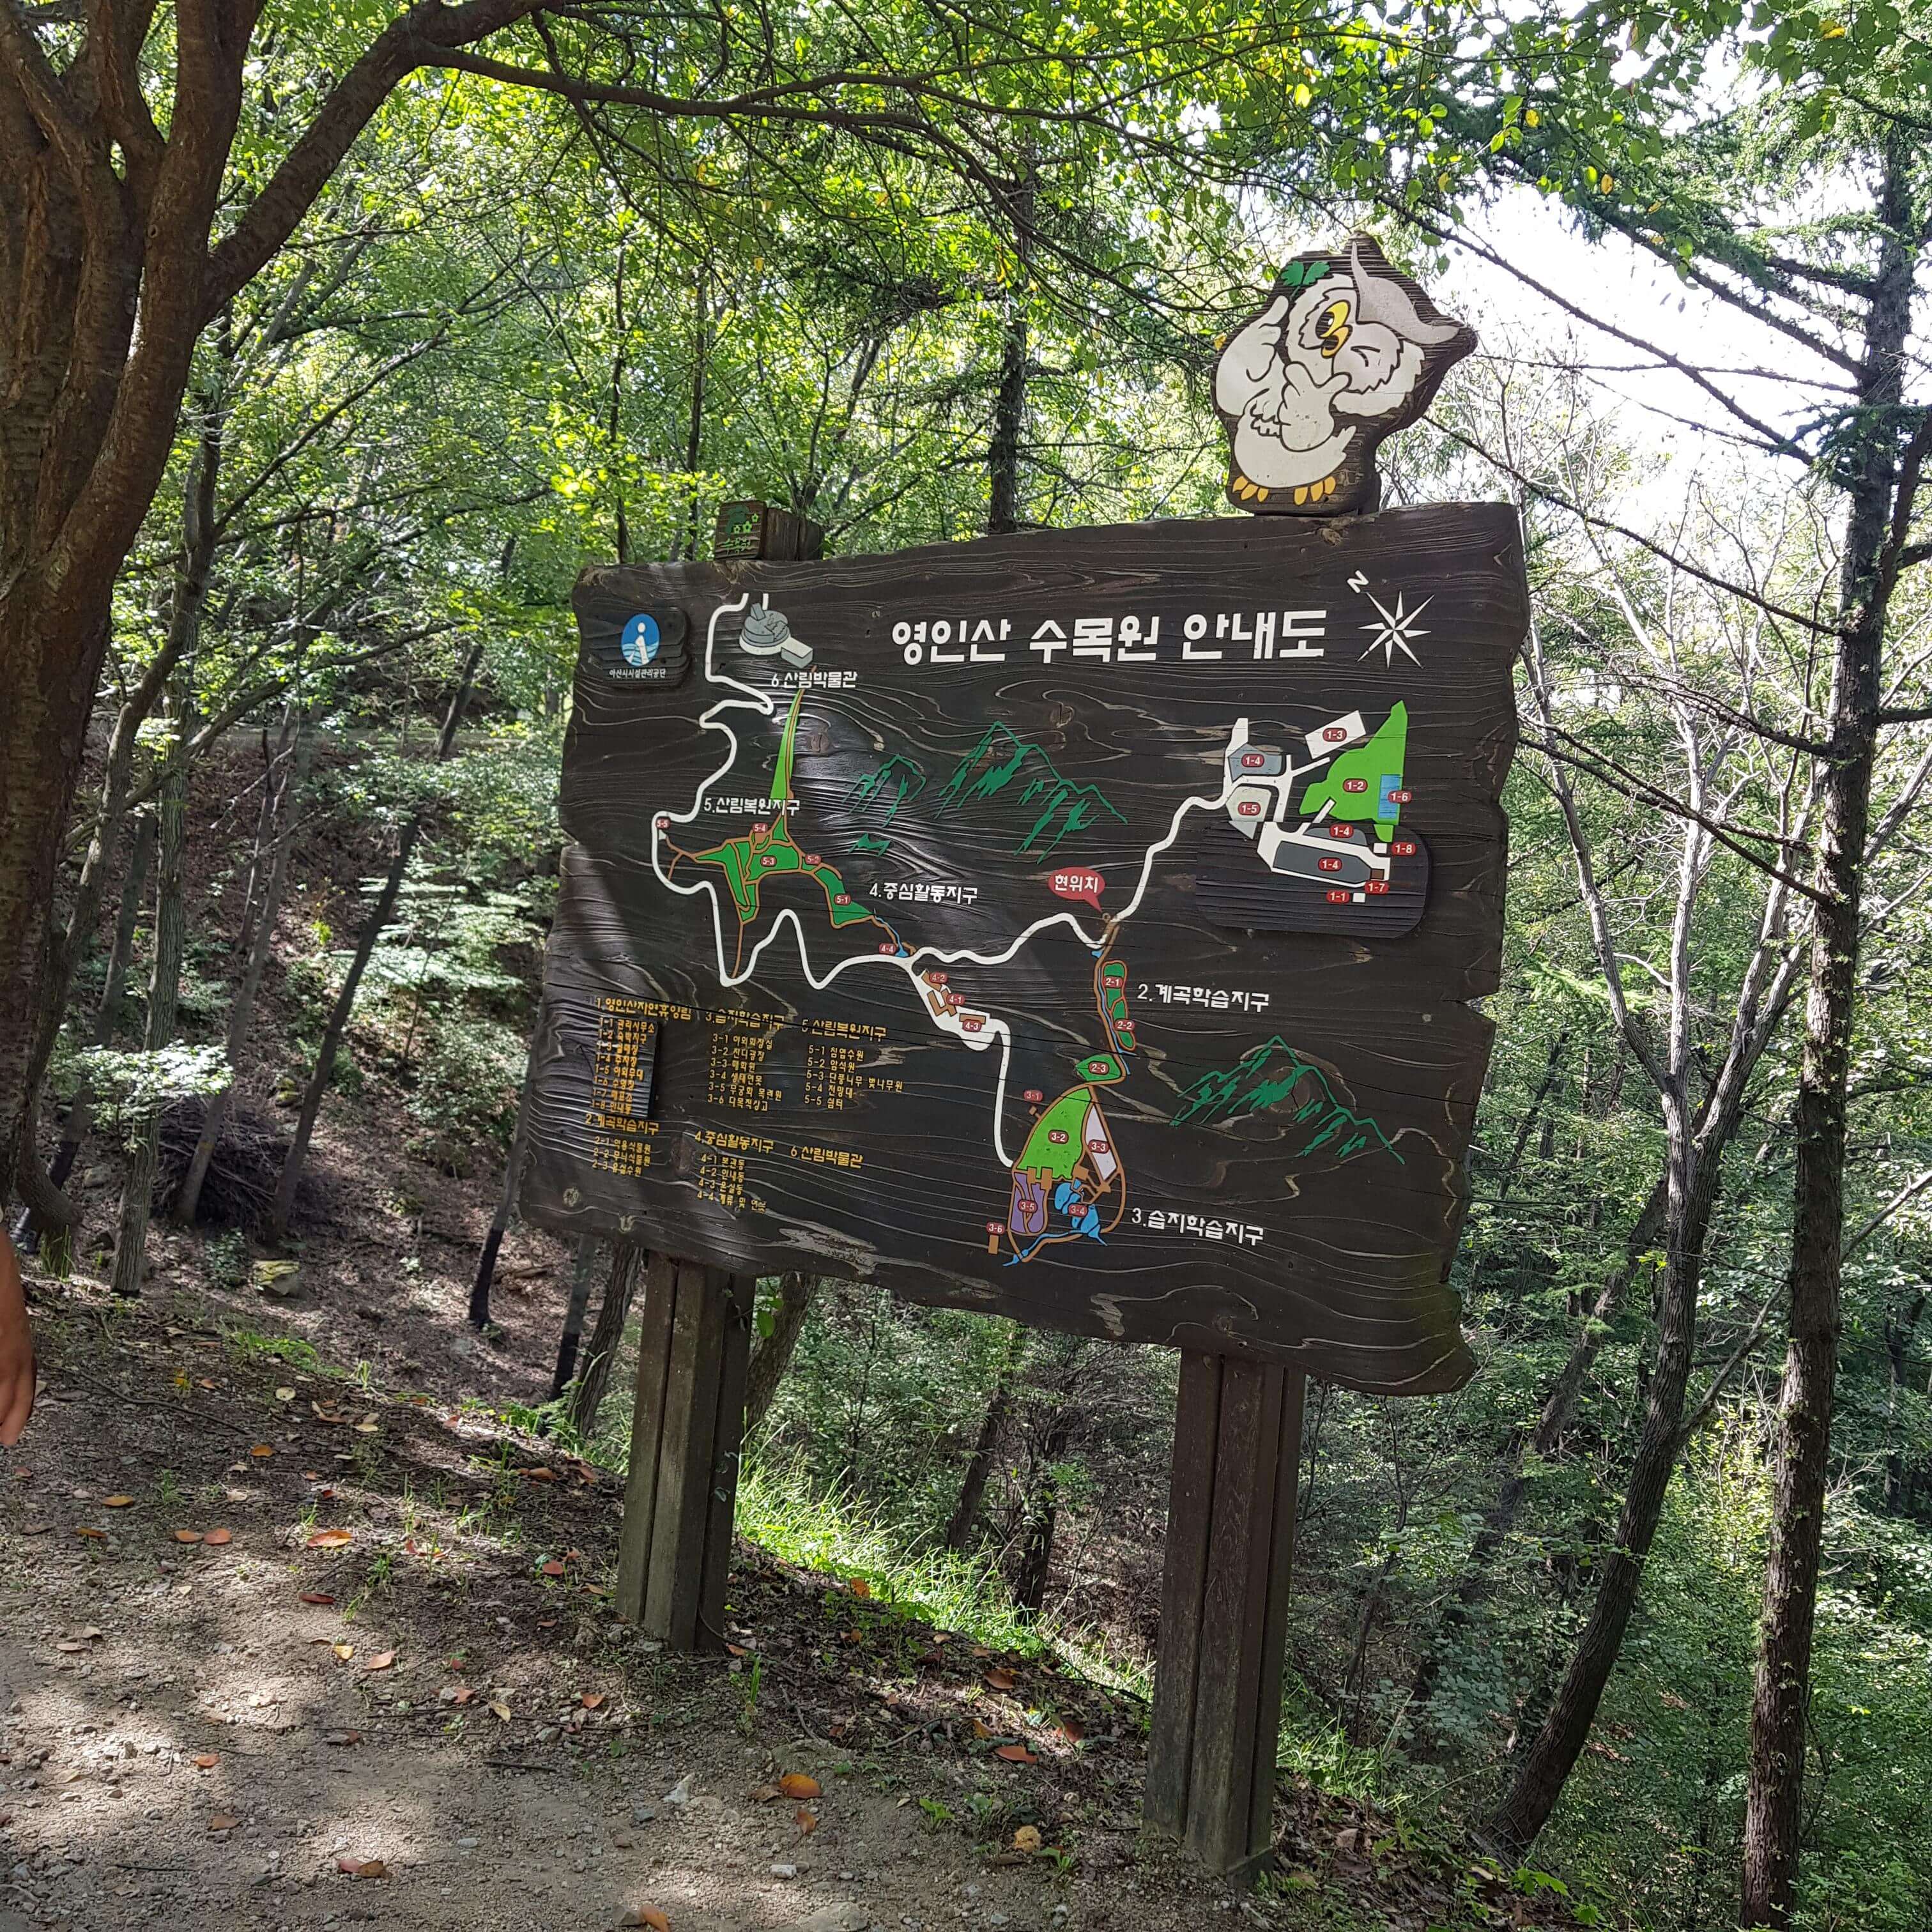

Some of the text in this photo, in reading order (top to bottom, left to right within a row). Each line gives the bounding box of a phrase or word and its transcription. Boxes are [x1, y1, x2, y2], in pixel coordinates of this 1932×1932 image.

[1347, 570, 1368, 593] N
[892, 610, 1326, 665] 영인산 수목원 안내도
[609, 668, 666, 678] 아산시시설관리공단
[1326, 730, 1344, 740] 1-3
[1245, 756, 1261, 766] 1-4
[1347, 781, 1364, 791] 1-2
[1392, 792, 1409, 802] 1-6
[1241, 805, 1257, 814] 1-5
[1333, 827, 1350, 836] 1-4
[1395, 845, 1412, 854] 1-8
[763, 857, 775, 866] 5-3
[807, 855, 820, 864] 5-2
[1322, 861, 1338, 869] 1-4
[1054, 874, 1098, 893] 현위치
[1368, 884, 1385, 893] 1-7
[1330, 893, 1346, 901] 1-1
[881, 944, 894, 953] 4-4
[1105, 978, 1121, 986] 2-1
[599, 1017, 655, 1033] 1-1 관리사무소
[965, 1022, 979, 1030] 4-3
[1117, 1022, 1133, 1030] 2-2
[599, 1029, 613, 1039] 1-2
[712, 1034, 728, 1043] 3-1
[712, 1046, 765, 1062] 3-2 잔디광장
[808, 1045, 825, 1055] 5-1
[597, 1053, 611, 1062] 1-4
[710, 1058, 728, 1068] 3-3
[808, 1057, 855, 1073] 5-2 암석원
[595, 1064, 610, 1074] 1-5
[1092, 1064, 1106, 1073] 2-3
[709, 1070, 726, 1079] 3-4
[806, 1070, 824, 1080] 5-3
[829, 1072, 862, 1087] 단풍나무
[594, 1075, 634, 1091] 1-6 수영장
[593, 1088, 606, 1097] 1-7
[709, 1082, 725, 1092] 3-5
[730, 1084, 753, 1097] 무궁화
[805, 1082, 853, 1098] 5-4 전망대
[707, 1094, 724, 1104] 3-6
[1026, 1091, 1039, 1100] 3-1
[592, 1099, 606, 1110] 1-8
[804, 1095, 843, 1110] 5-5 쉼터
[595, 1136, 609, 1145] 2-1
[1051, 1132, 1066, 1141] 3-2
[1092, 1142, 1106, 1151] 3-3
[594, 1147, 609, 1158] 2-2
[701, 1154, 717, 1164] 4-1
[592, 1159, 608, 1170] 2-3
[700, 1166, 716, 1176] 4-2
[699, 1178, 715, 1189] 4-3
[697, 1190, 714, 1200] 4-4
[1021, 1202, 1035, 1210] 3-5
[1071, 1206, 1085, 1215] 3-4
[989, 1224, 1002, 1233] 3-6
